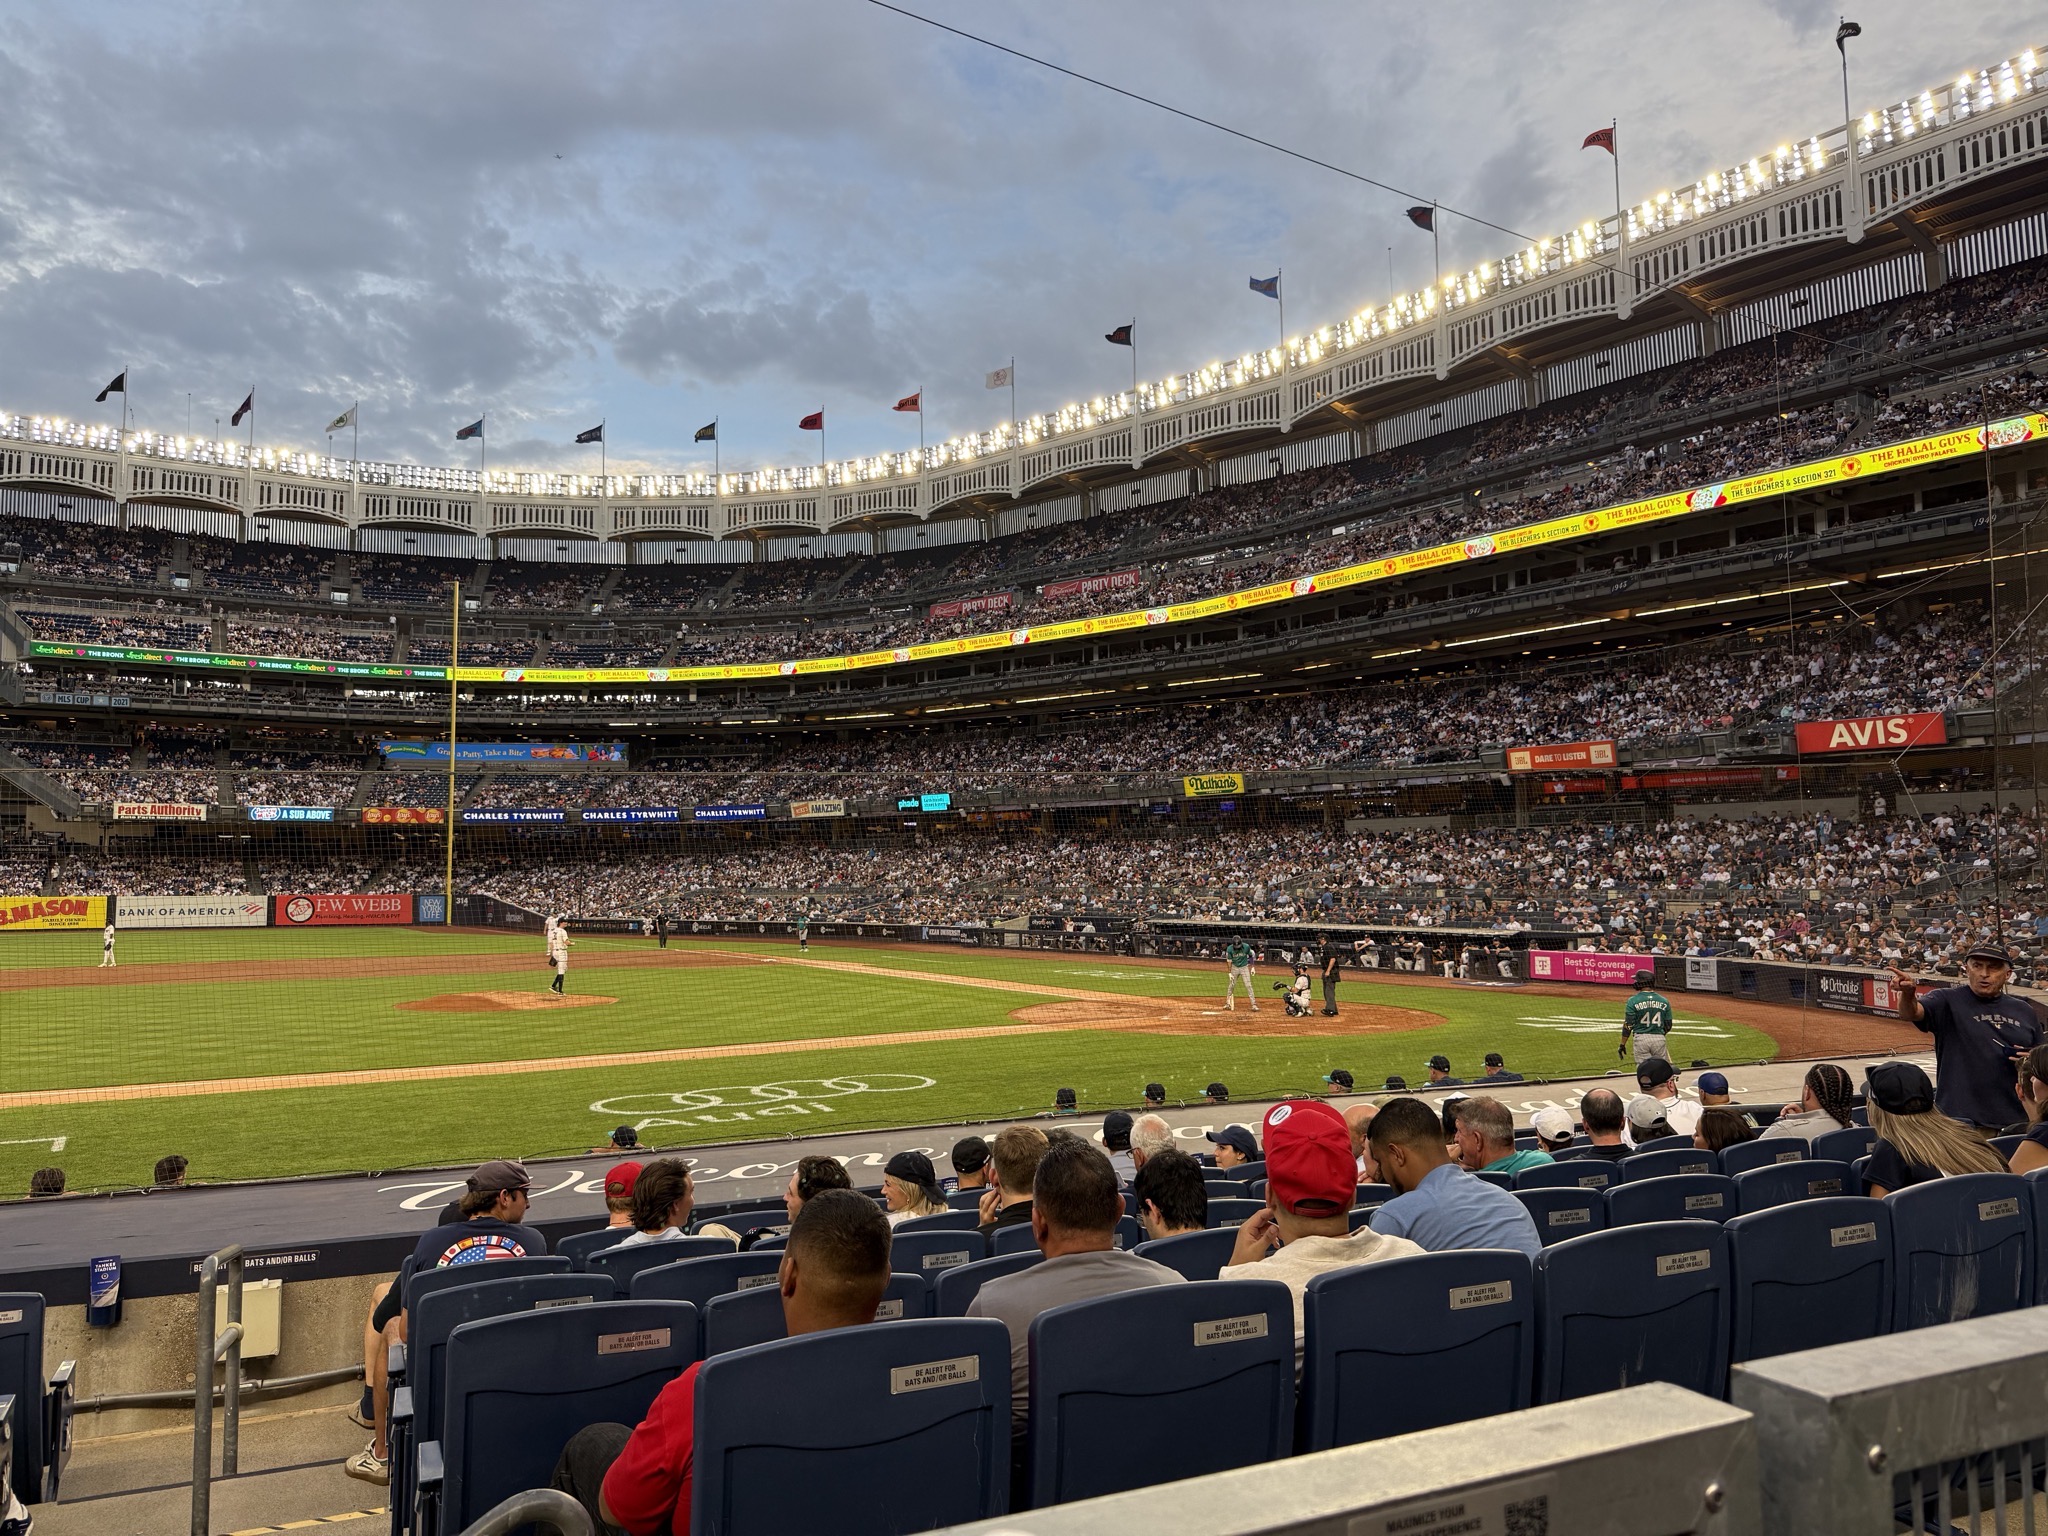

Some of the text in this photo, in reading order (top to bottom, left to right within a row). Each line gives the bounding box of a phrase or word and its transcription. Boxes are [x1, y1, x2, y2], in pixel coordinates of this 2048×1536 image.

[1870, 434, 1970, 462] THE HALAL GUYS
[1884, 448, 1957, 468] CHICKEN GYRO FALAFEL
[1732, 488, 1744, 497] THE
[1746, 480, 1784, 494] BLEACHERS
[1793, 474, 1822, 485] SECTION
[1824, 470, 1836, 478] 321
[1606, 497, 1681, 520] THE HALAL GUYS
[1974, 514, 1997, 527] 1949
[1510, 533, 1540, 546] BLEACHERS
[1547, 527, 1569, 538] SECTION
[1571, 524, 1580, 532] 321
[1401, 545, 1460, 565] THE HALAL GUYS
[1081, 577, 1109, 592] PARTY
[1112, 572, 1135, 587] DECK
[962, 601, 986, 613] PARTY
[988, 595, 1009, 609] DECK
[1110, 616, 1127, 624] HALAL
[36, 645, 73, 656] freshdirect
[126, 649, 162, 661] freshdirect
[212, 657, 246, 667] freshdirect
[293, 662, 325, 672] freshdirect
[371, 667, 402, 676] freshdirect
[76, 696, 89, 704] CUP
[113, 698, 128, 706] 2021
[1829, 718, 1908, 748] AVIS
[1515, 756, 1528, 765] JBL
[1535, 754, 1553, 763] DARE
[1563, 752, 1586, 760] LISTEN
[1595, 750, 1608, 758] JBL
[1189, 777, 1238, 791] Nathan's
[118, 805, 202, 816] Parts Authority
[811, 804, 841, 813] AMAZING
[898, 798, 919, 811] phade
[282, 810, 288, 819] A
[290, 810, 305, 819] SUB
[306, 810, 332, 819] ABOVE
[464, 812, 564, 820] CHARLES TYRWHITT
[630, 811, 678, 819] TYRWHITT
[317, 899, 401, 911] F.W. WEBB
[120, 908, 154, 916] BANK
[178, 908, 235, 916] AMERICA
[1564, 958, 1635, 971] Best 5G coverage
[1585, 967, 1598, 977] the
[1601, 969, 1624, 979] game
[1830, 978, 1859, 995] Ortholite
[1635, 1000, 1667, 1011] RODRIGUEZ
[1640, 1011, 1662, 1027] 44
[194, 1264, 202, 1272] BE
[245, 1257, 264, 1267] BATS
[266, 1255, 293, 1265] AND/OR
[294, 1253, 316, 1263] BALLS
[1472, 1295, 1490, 1303] AND/OR
[1223, 1322, 1238, 1330] ALERT
[925, 1366, 943, 1375] ALERT
[945, 1364, 956, 1372] FOR
[905, 1370, 966, 1387] BATS AND/OR BALLS
[1387, 1511, 1438, 1532] MAXIMIZE
[1440, 1505, 1465, 1520] YOUR
